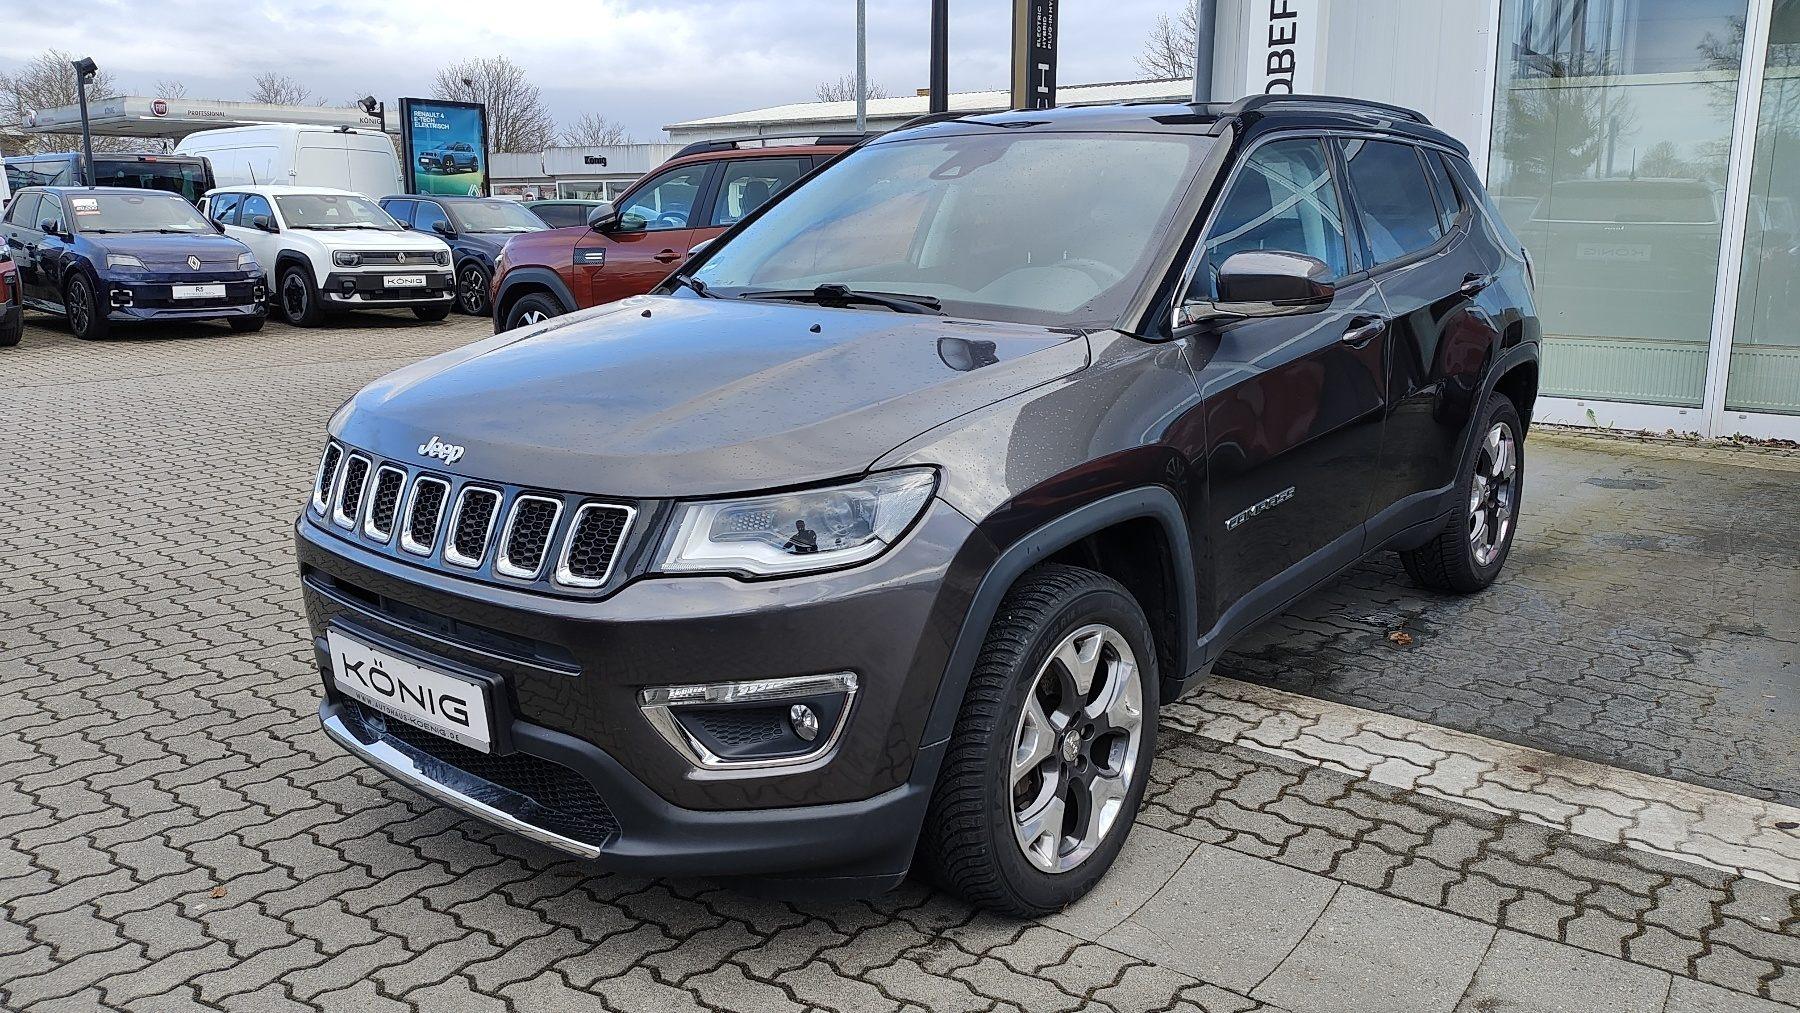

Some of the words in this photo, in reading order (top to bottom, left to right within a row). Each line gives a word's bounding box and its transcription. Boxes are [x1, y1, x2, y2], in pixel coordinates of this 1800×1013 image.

[187, 109, 226, 118] PROFESSIONAL
[413, 110, 440, 118] RENAULT
[359, 116, 381, 125] KÖNIG
[414, 122, 450, 130] ELEKTRISCH
[417, 435, 465, 466] Jeep
[1224, 486, 1296, 531] COMPASS
[341, 652, 470, 728] KÖNIG
